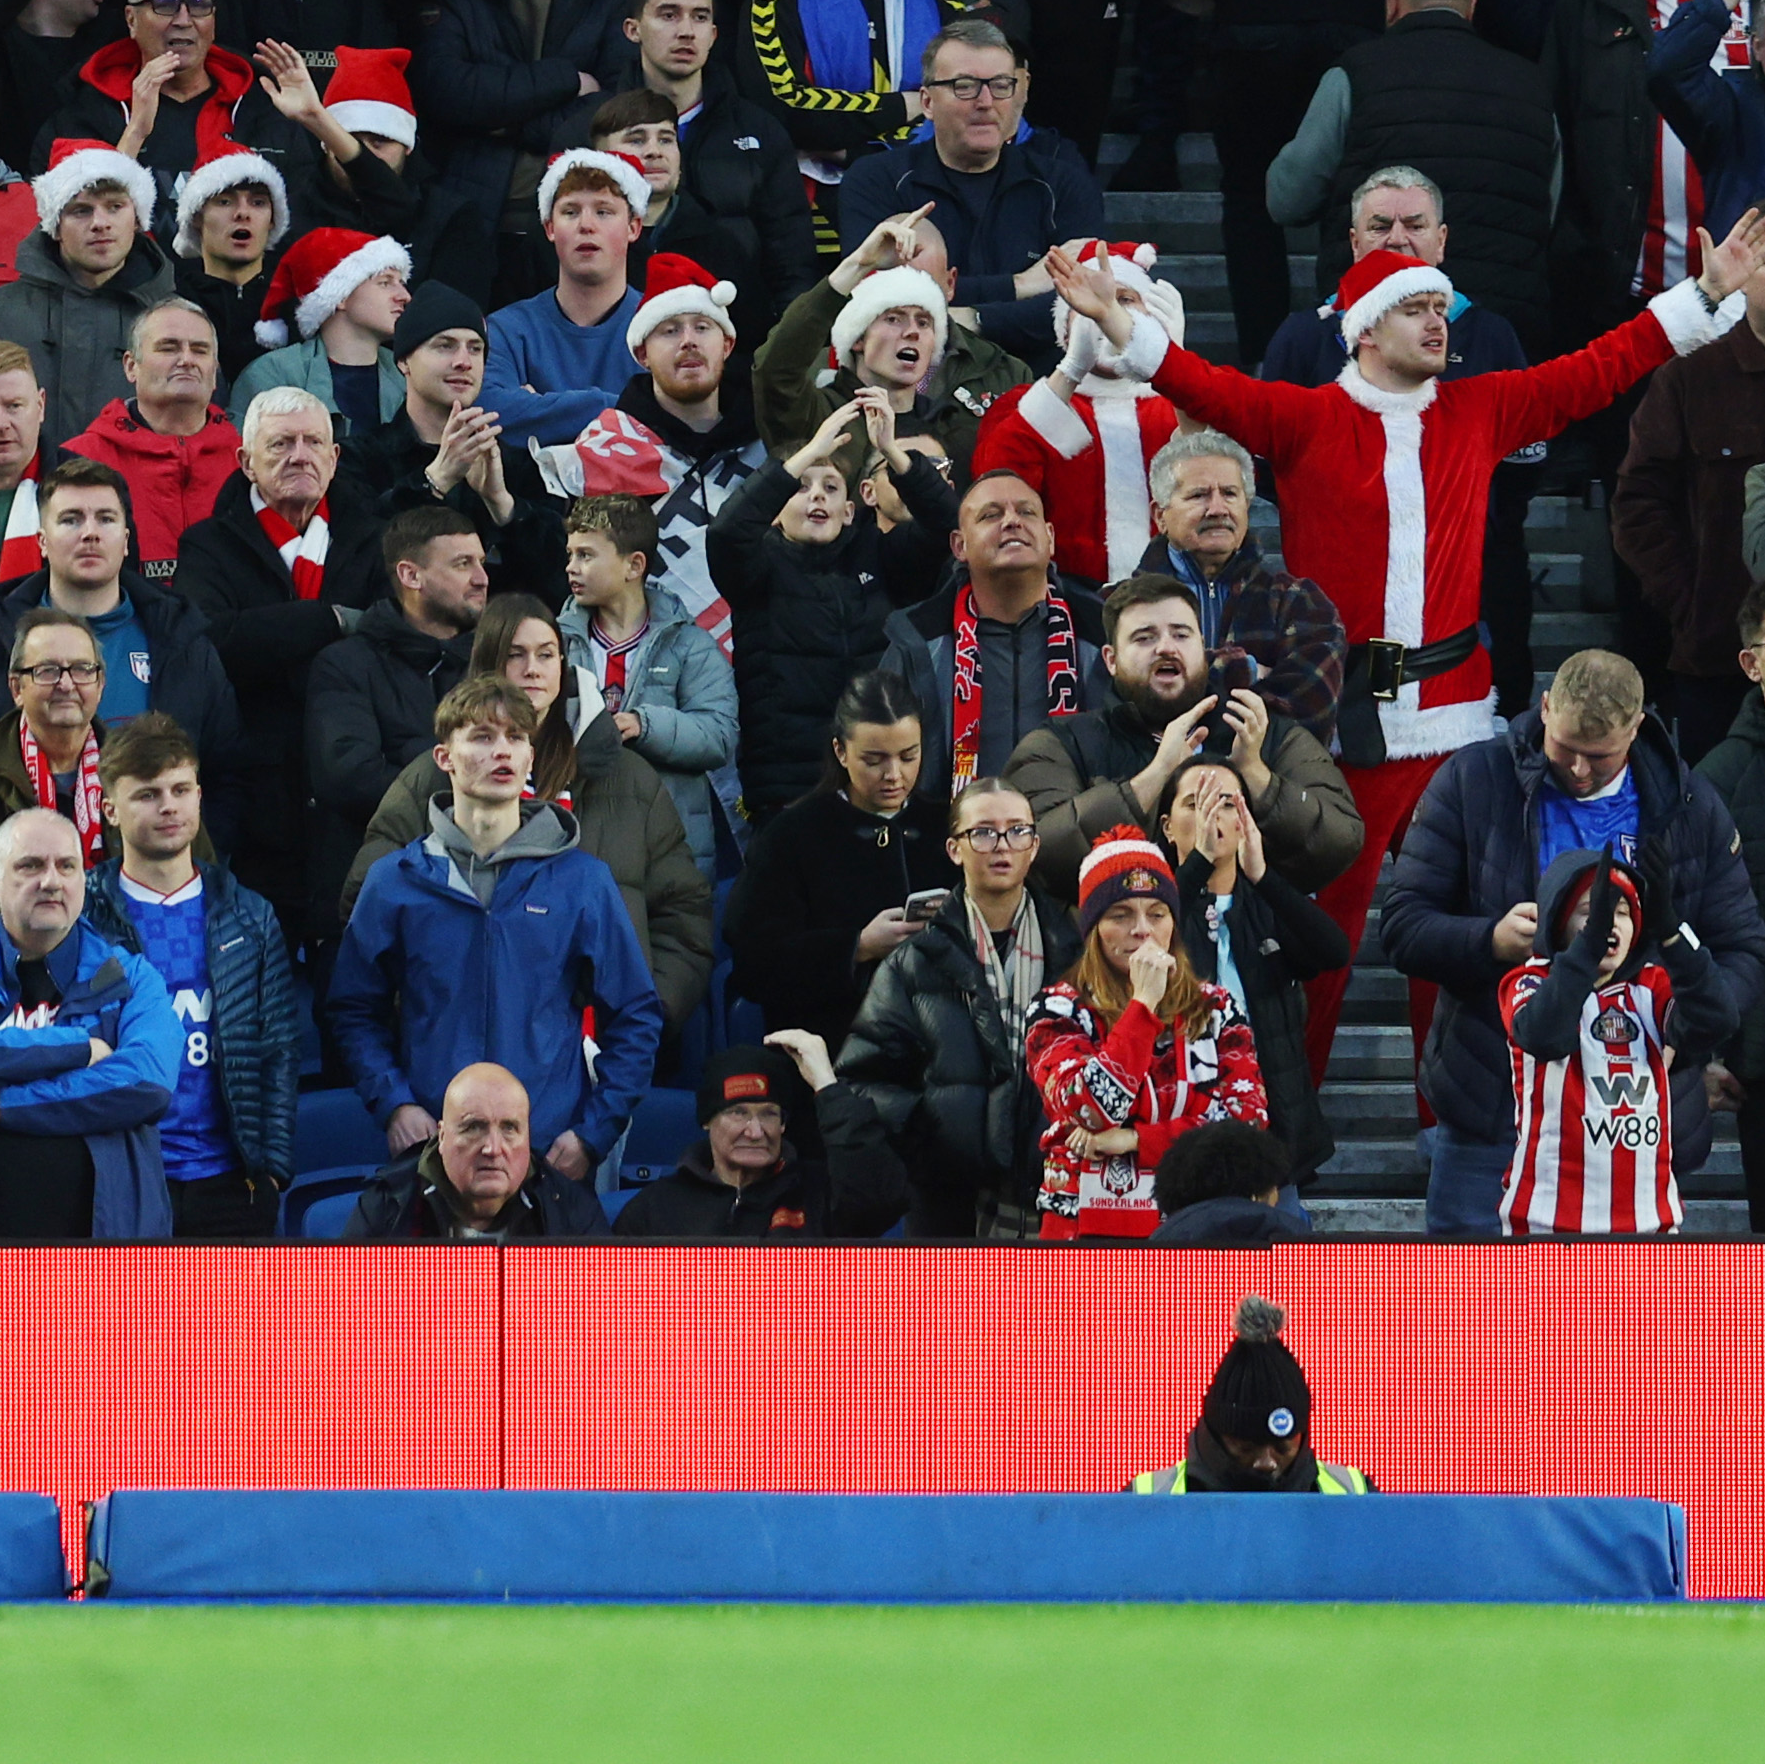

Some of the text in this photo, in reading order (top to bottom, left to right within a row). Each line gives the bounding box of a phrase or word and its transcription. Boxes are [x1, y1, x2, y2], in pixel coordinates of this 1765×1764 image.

[1590, 1076, 1649, 1107] W
[1582, 1115, 1660, 1149] W88
[1088, 1196, 1152, 1209] SUNDERLAND
